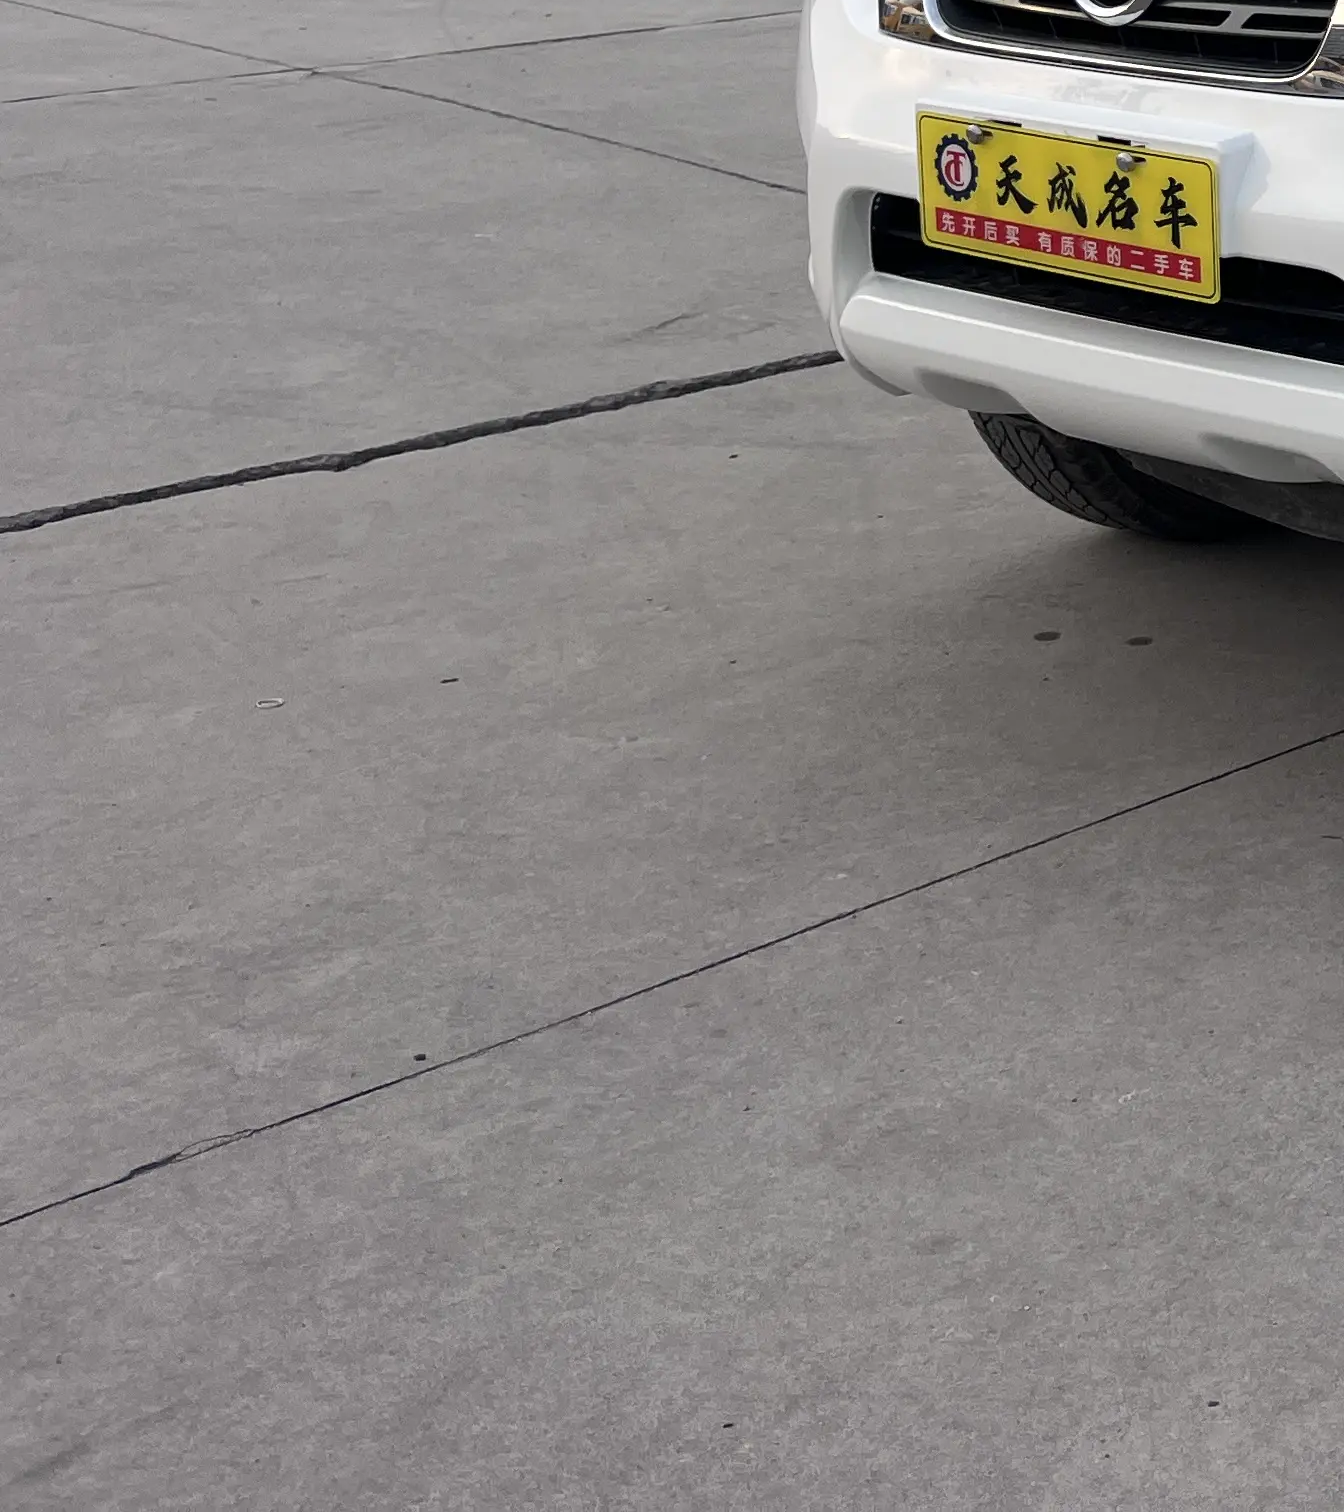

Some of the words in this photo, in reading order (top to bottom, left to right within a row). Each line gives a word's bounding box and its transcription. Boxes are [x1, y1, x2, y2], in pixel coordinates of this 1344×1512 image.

[940, 211, 1021, 247] 先开后买
[1036, 231, 1195, 282] 有质保的二手车
